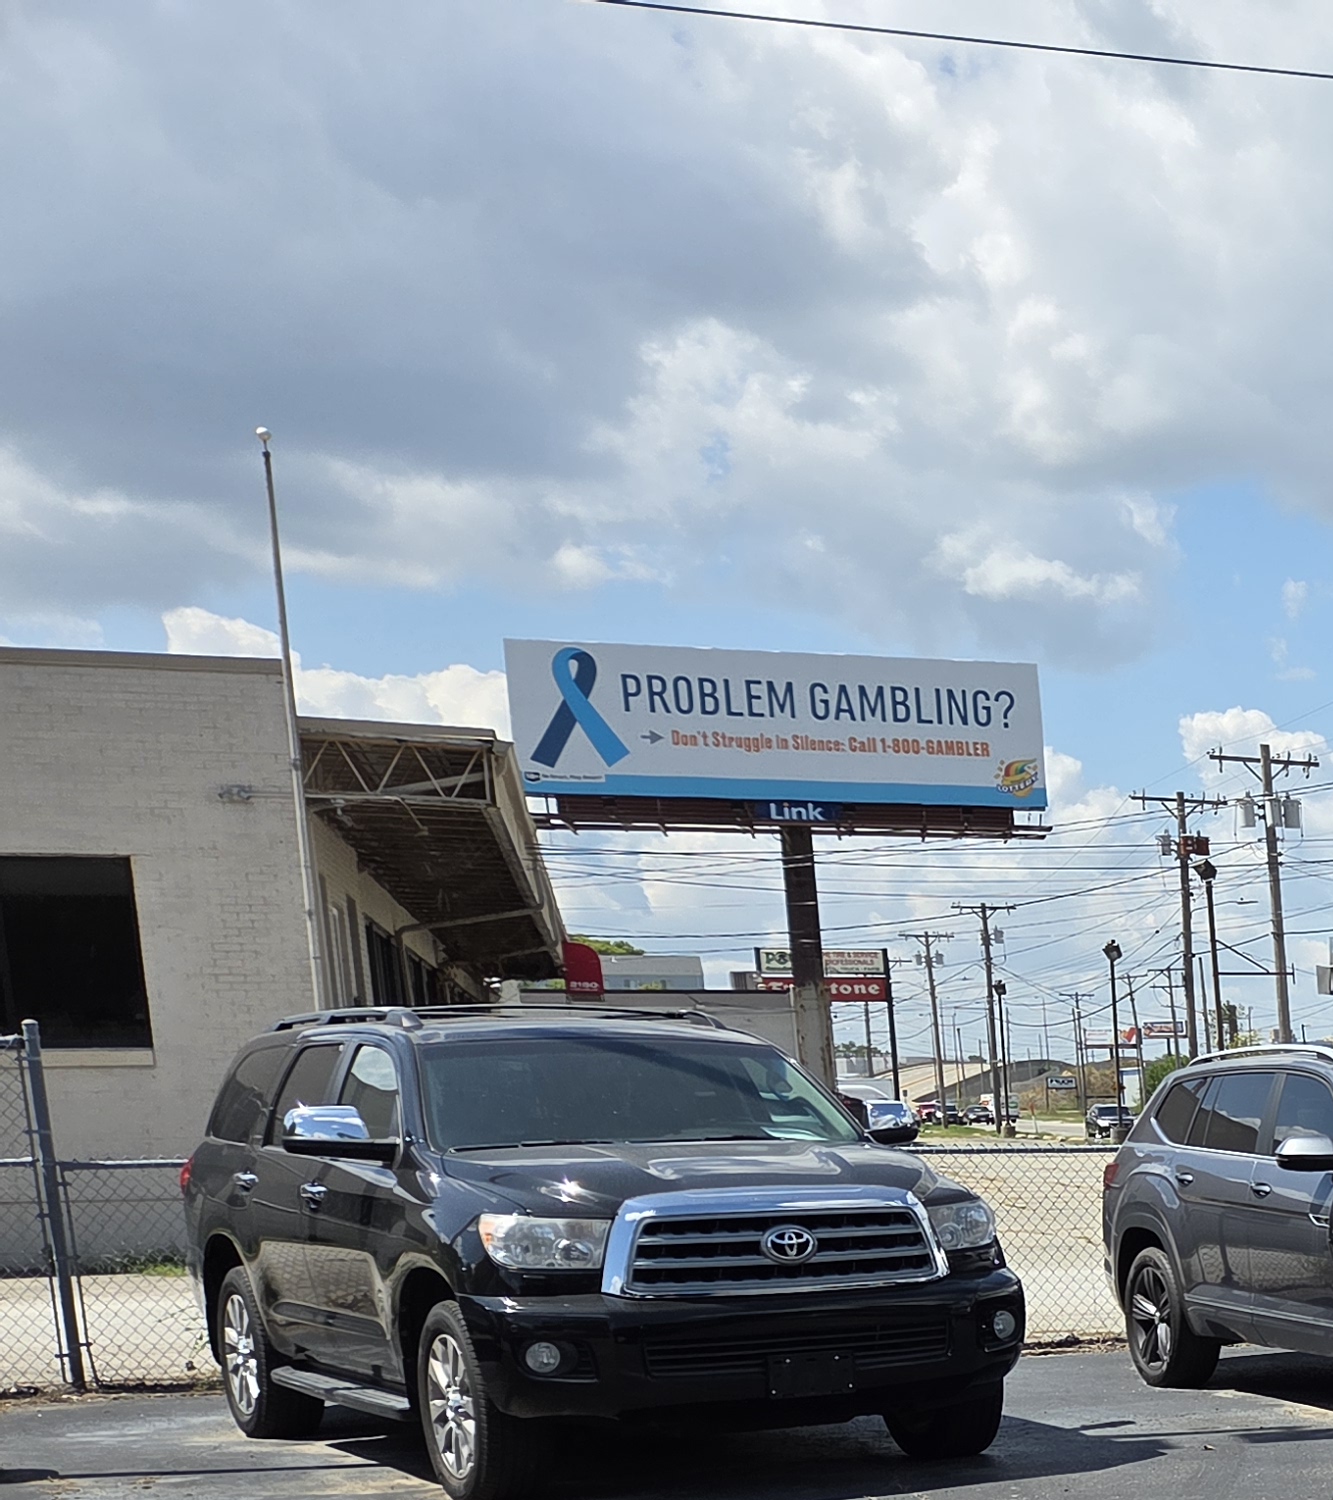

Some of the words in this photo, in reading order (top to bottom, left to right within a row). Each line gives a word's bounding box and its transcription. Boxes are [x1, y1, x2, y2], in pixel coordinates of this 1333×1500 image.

[620, 673, 797, 719] PROBLEM
[808, 682, 1015, 729] GAMBLING?
[671, 729, 710, 747] Don't
[711, 730, 773, 753] Struggle
[776, 733, 789, 750] in
[792, 733, 845, 752] Silence:
[848, 736, 877, 754] Call
[879, 737, 991, 758] 1-800-GAMBLER
[996, 771, 1039, 794] LOTTERY
[769, 801, 827, 821] Link
